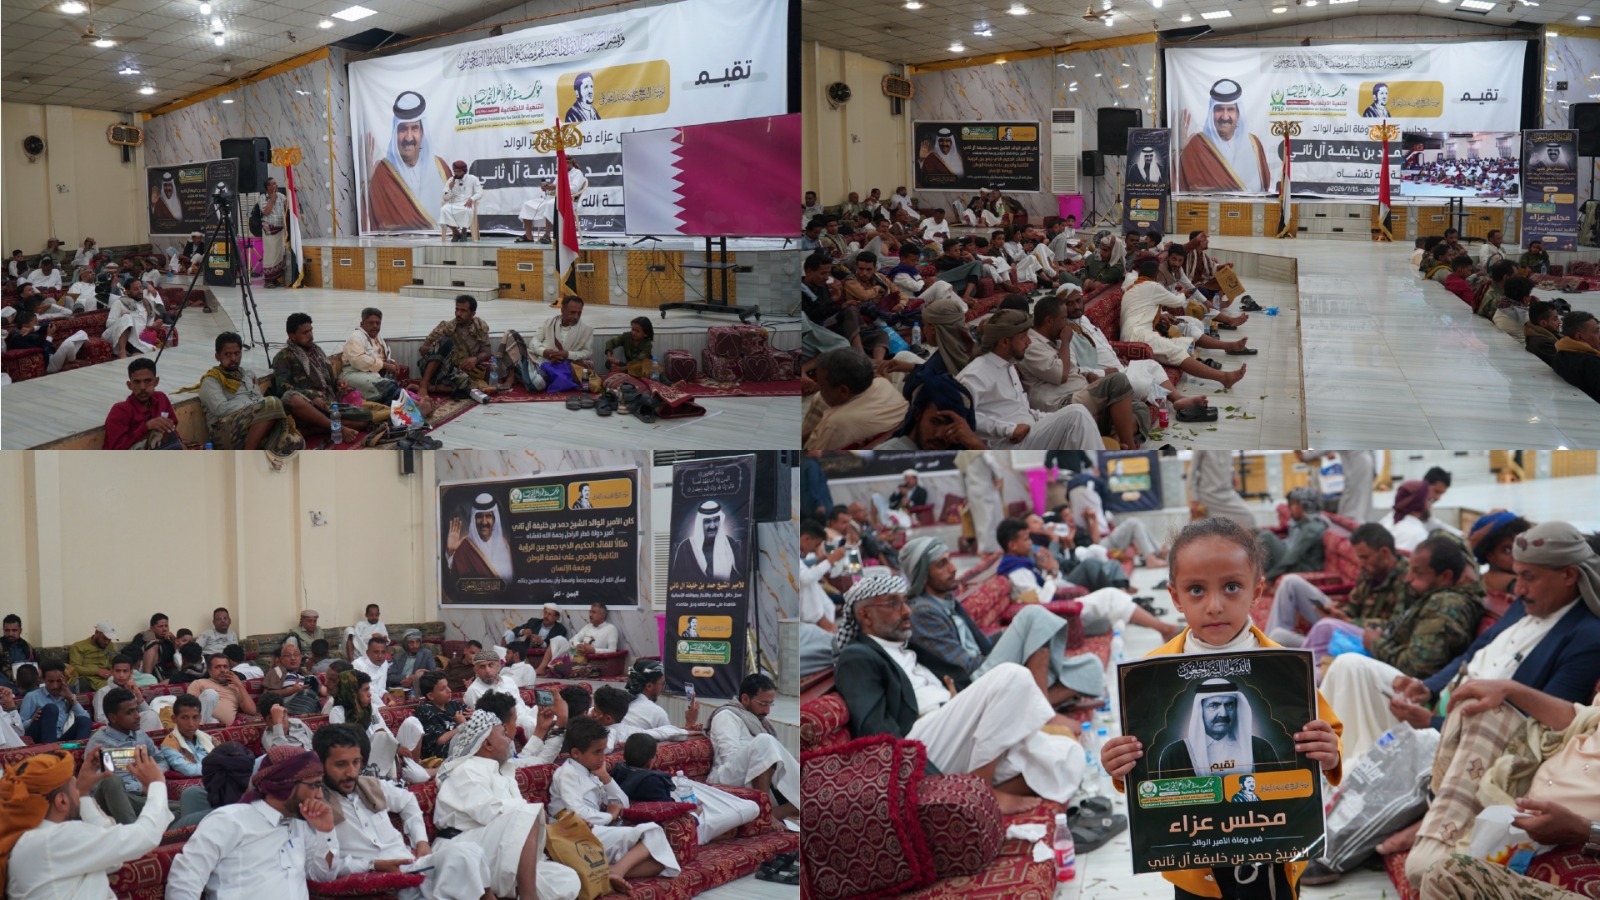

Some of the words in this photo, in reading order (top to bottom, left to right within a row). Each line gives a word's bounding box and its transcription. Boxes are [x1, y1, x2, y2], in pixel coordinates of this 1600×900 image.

[694, 60, 752, 88] تقيم
[1460, 88, 1500, 106] تقيم
[458, 117, 474, 126] FFSD
[1312, 125, 1332, 135] الوالد
[1333, 123, 1351, 135] الأمير
[504, 136, 526, 150] الوالد
[595, 131, 614, 145] عزاء
[1290, 142, 1313, 161] ثاني
[1314, 142, 1326, 160] آل
[1328, 146, 1360, 160] خليفة
[1362, 148, 1375, 160] بن
[478, 162, 506, 184] ثاني
[508, 160, 520, 184] آل
[523, 163, 558, 182] ليفة
[1336, 170, 1373, 179] تغشاه
[582, 194, 598, 208] الله
[526, 520, 532, 531] آل
[532, 520, 548, 530] خليفة
[550, 522, 557, 530] بن
[570, 519, 588, 530] الشيخ
[588, 518, 605, 528] الوالد
[606, 518, 622, 528] الأمير
[624, 517, 634, 526] كان
[564, 530, 579, 538] الراحل
[580, 530, 590, 538] قطر
[604, 528, 614, 538] أمير
[559, 542, 574, 551] الذي
[574, 541, 594, 551] الحكيم
[526, 554, 544, 563] الوطن
[562, 552, 575, 560] على
[576, 552, 598, 562] والحرص
[572, 564, 592, 574] ورفعة
[698, 582, 704, 590] بن
[716, 581, 730, 590] الشيخ
[566, 590, 580, 598] اليمن
[1210, 760, 1235, 772] تقيم
[1169, 814, 1214, 838] عزاء
[1221, 810, 1287, 832] مجلس
[1192, 838, 1211, 848] الوالد
[1212, 836, 1230, 847] الأمير
[1232, 836, 1248, 846] وفاة
[1250, 836, 1263, 844] في
[1178, 851, 1190, 868] آل
[1194, 852, 1228, 866] خليفة
[1230, 854, 1244, 865] بن
[1248, 854, 1272, 862] حمد
[1274, 846, 1309, 863] الشيخ
[1148, 853, 1175, 870] ثاني
